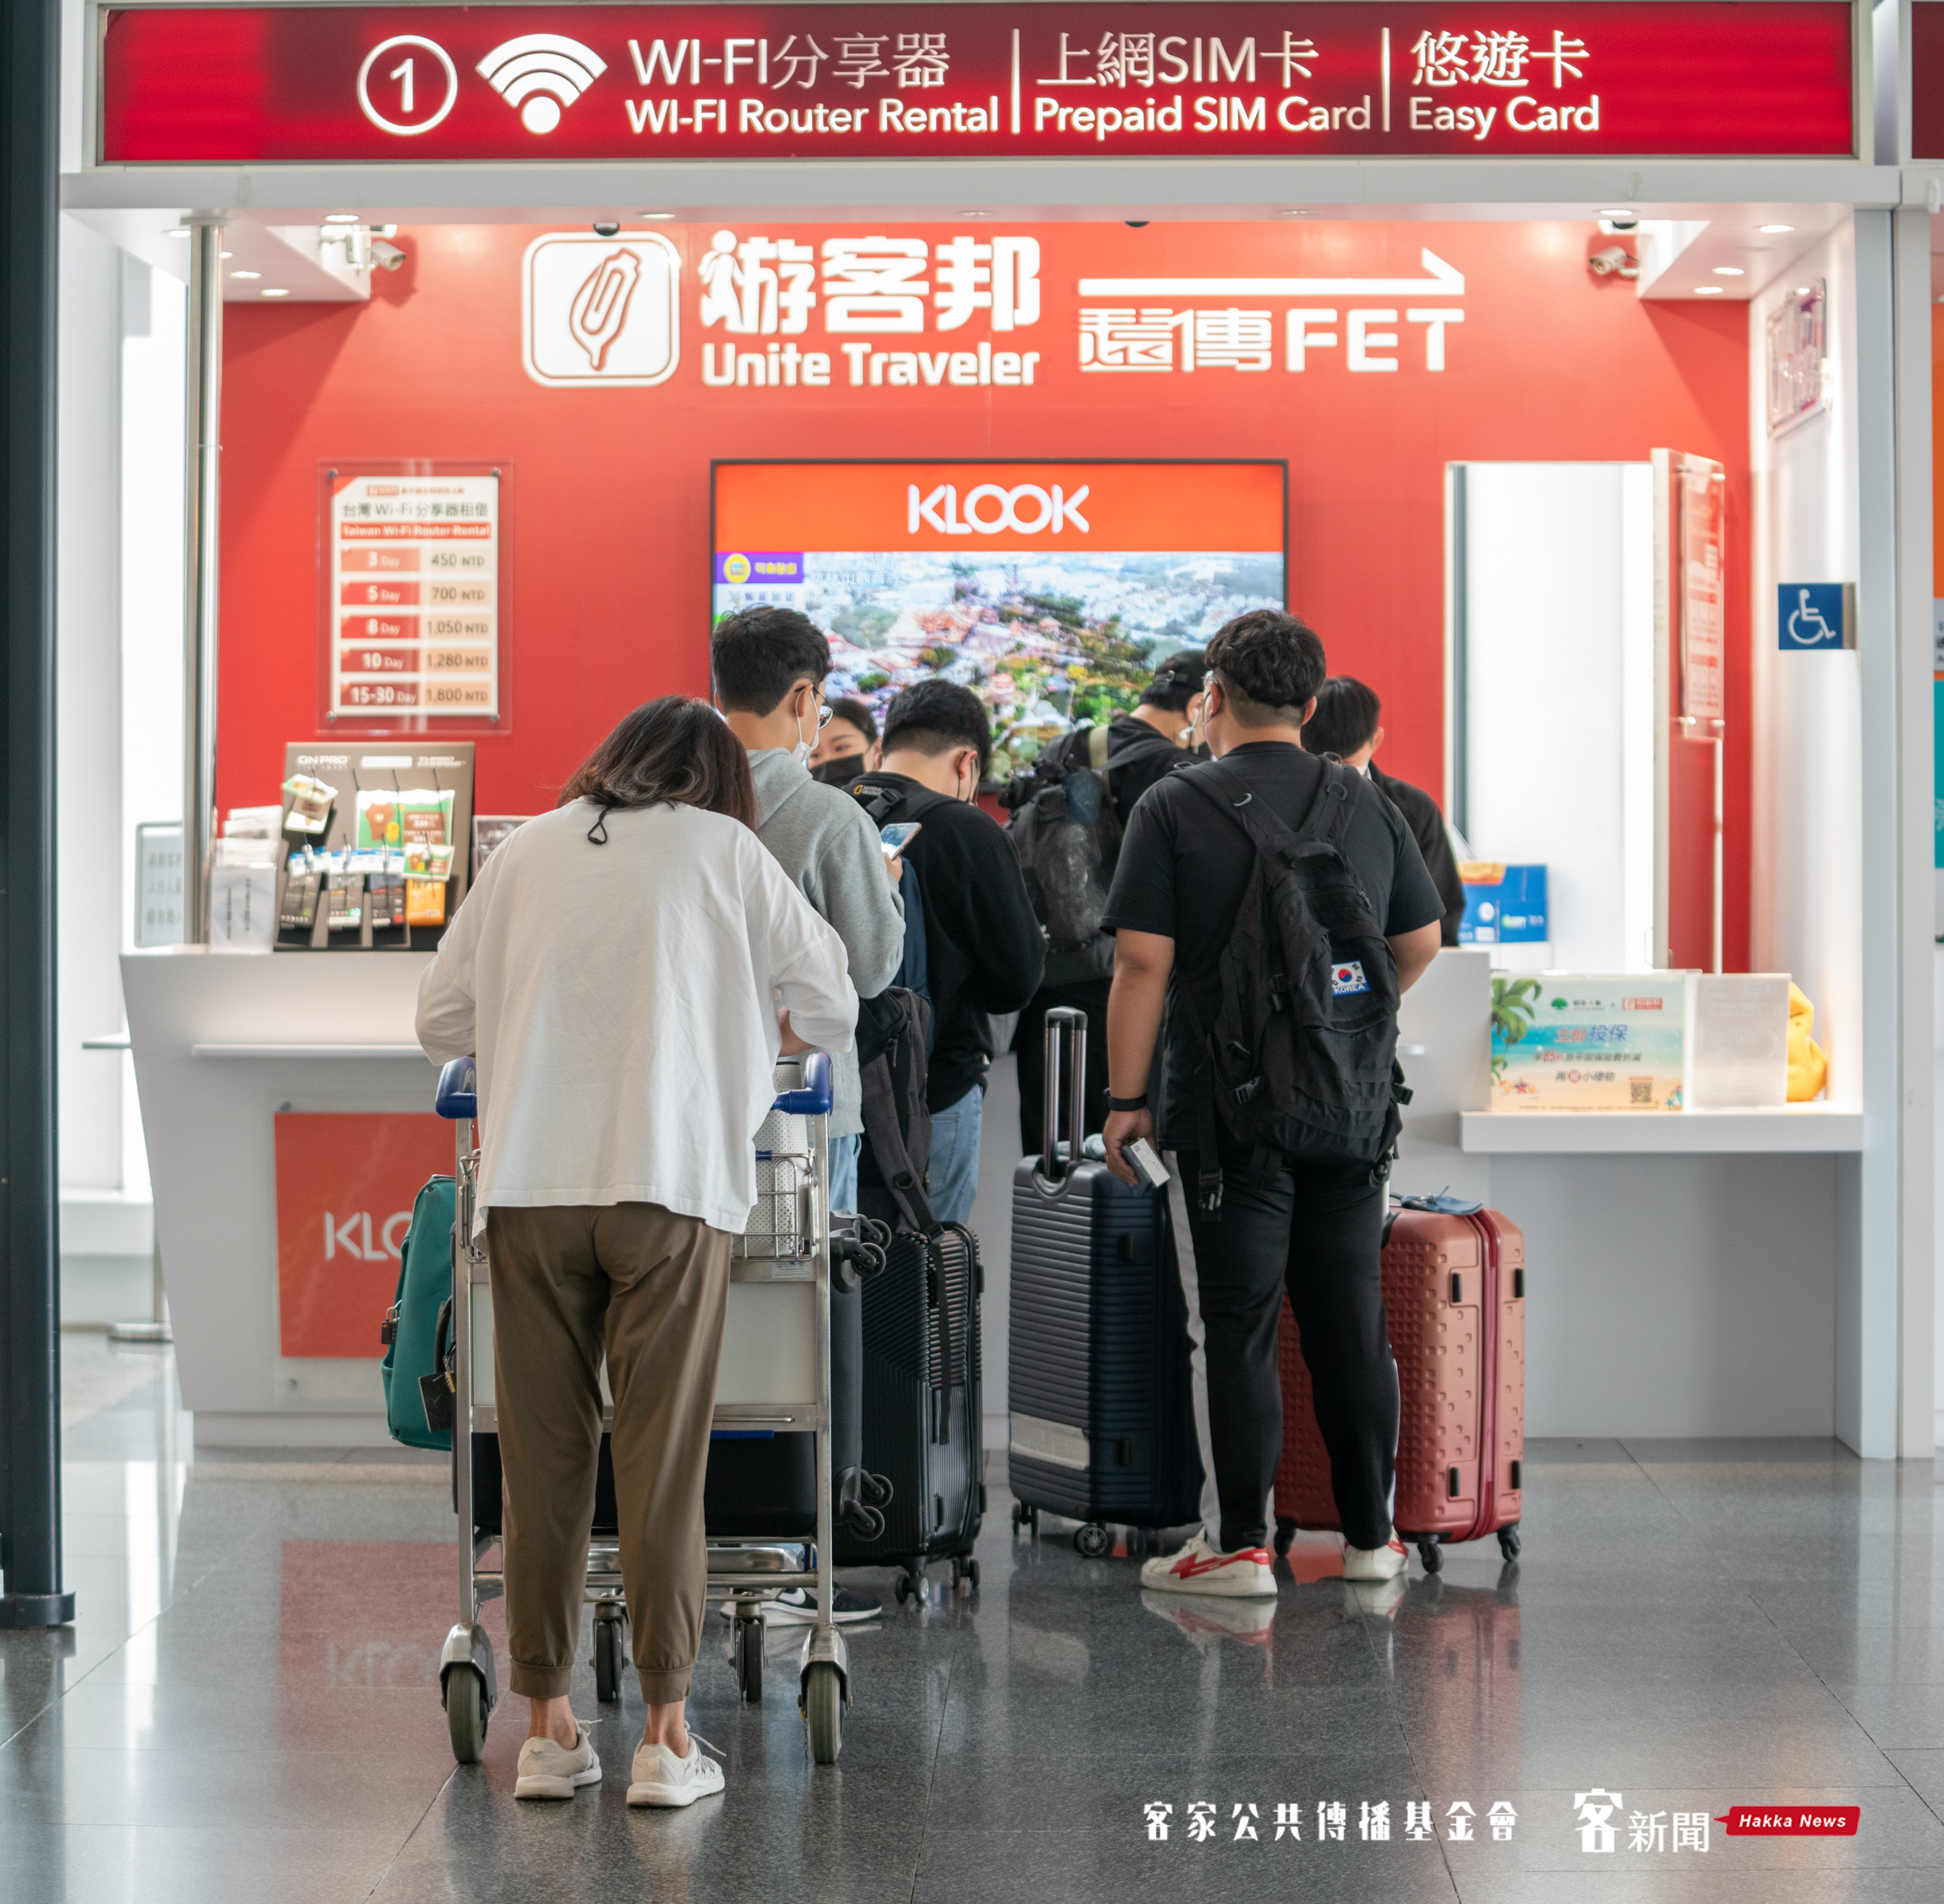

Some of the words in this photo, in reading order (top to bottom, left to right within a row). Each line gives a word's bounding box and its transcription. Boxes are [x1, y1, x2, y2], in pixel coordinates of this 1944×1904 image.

[629, 34, 950, 89] WI-FI分享器
[1037, 31, 1319, 88] 上網SIM卡
[1411, 30, 1590, 89] 悠遊卡
[389, 58, 414, 112] 1
[625, 99, 727, 133] WI-FI
[739, 99, 869, 133] Router
[879, 96, 999, 133] Rental
[1035, 95, 1182, 141] Prepaid
[1194, 97, 1266, 132] SIM
[1278, 95, 1370, 132] Card
[1410, 97, 1496, 140] Easy
[1506, 95, 1599, 132] Card
[1286, 309, 1465, 372] FET
[704, 343, 830, 385] Unite
[842, 342, 1040, 385] Traveler
[343, 503, 371, 517] 台灣
[376, 503, 412, 516] Wi-Fi
[908, 483, 1090, 534] KLOOK
[343, 525, 381, 537] Taiwan
[384, 525, 412, 537] Wi-Fi
[414, 525, 451, 537] Router
[453, 525, 490, 537] Rental
[381, 555, 400, 569] Day
[432, 553, 457, 567] 450
[462, 555, 485, 566] NTD
[368, 585, 378, 601] 5
[381, 589, 400, 602] Day
[432, 586, 457, 601] 700
[462, 589, 485, 600] NTD
[381, 622, 400, 637] Day
[427, 621, 462, 635] 1,050
[465, 622, 488, 633] NTD
[362, 652, 382, 669] 10
[385, 656, 404, 670] Day
[427, 653, 462, 668] 1,280
[465, 656, 488, 667] NTD
[350, 687, 395, 704] 15-30
[398, 691, 416, 705] Day
[427, 688, 462, 702] 1,800
[465, 690, 488, 701] NTD
[1335, 984, 1366, 994] KOREA
[324, 1210, 414, 1262] KLO
